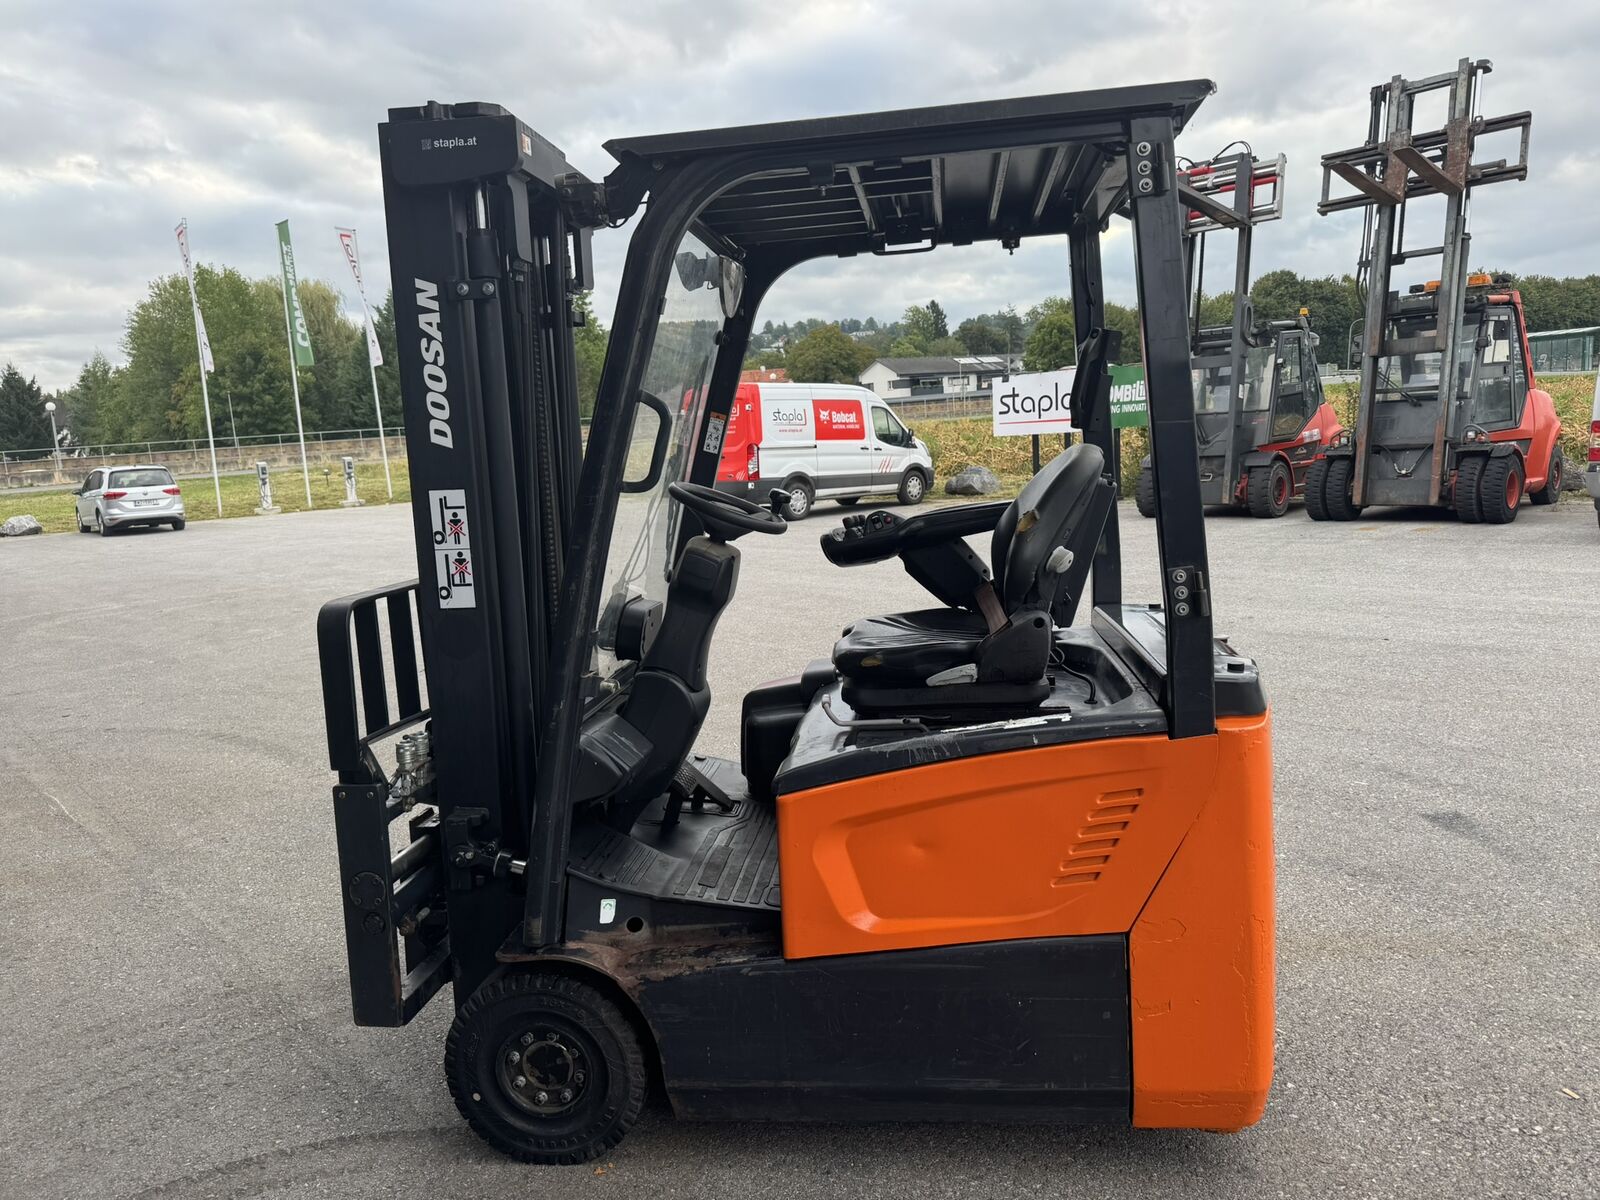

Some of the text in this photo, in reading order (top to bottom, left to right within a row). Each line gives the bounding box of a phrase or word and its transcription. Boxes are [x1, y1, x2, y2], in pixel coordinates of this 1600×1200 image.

[433, 136, 477, 149] stapla.at
[415, 278, 454, 449] DOOSAN
[772, 408, 804, 424] stapla
[831, 411, 857, 423] Bobcat
